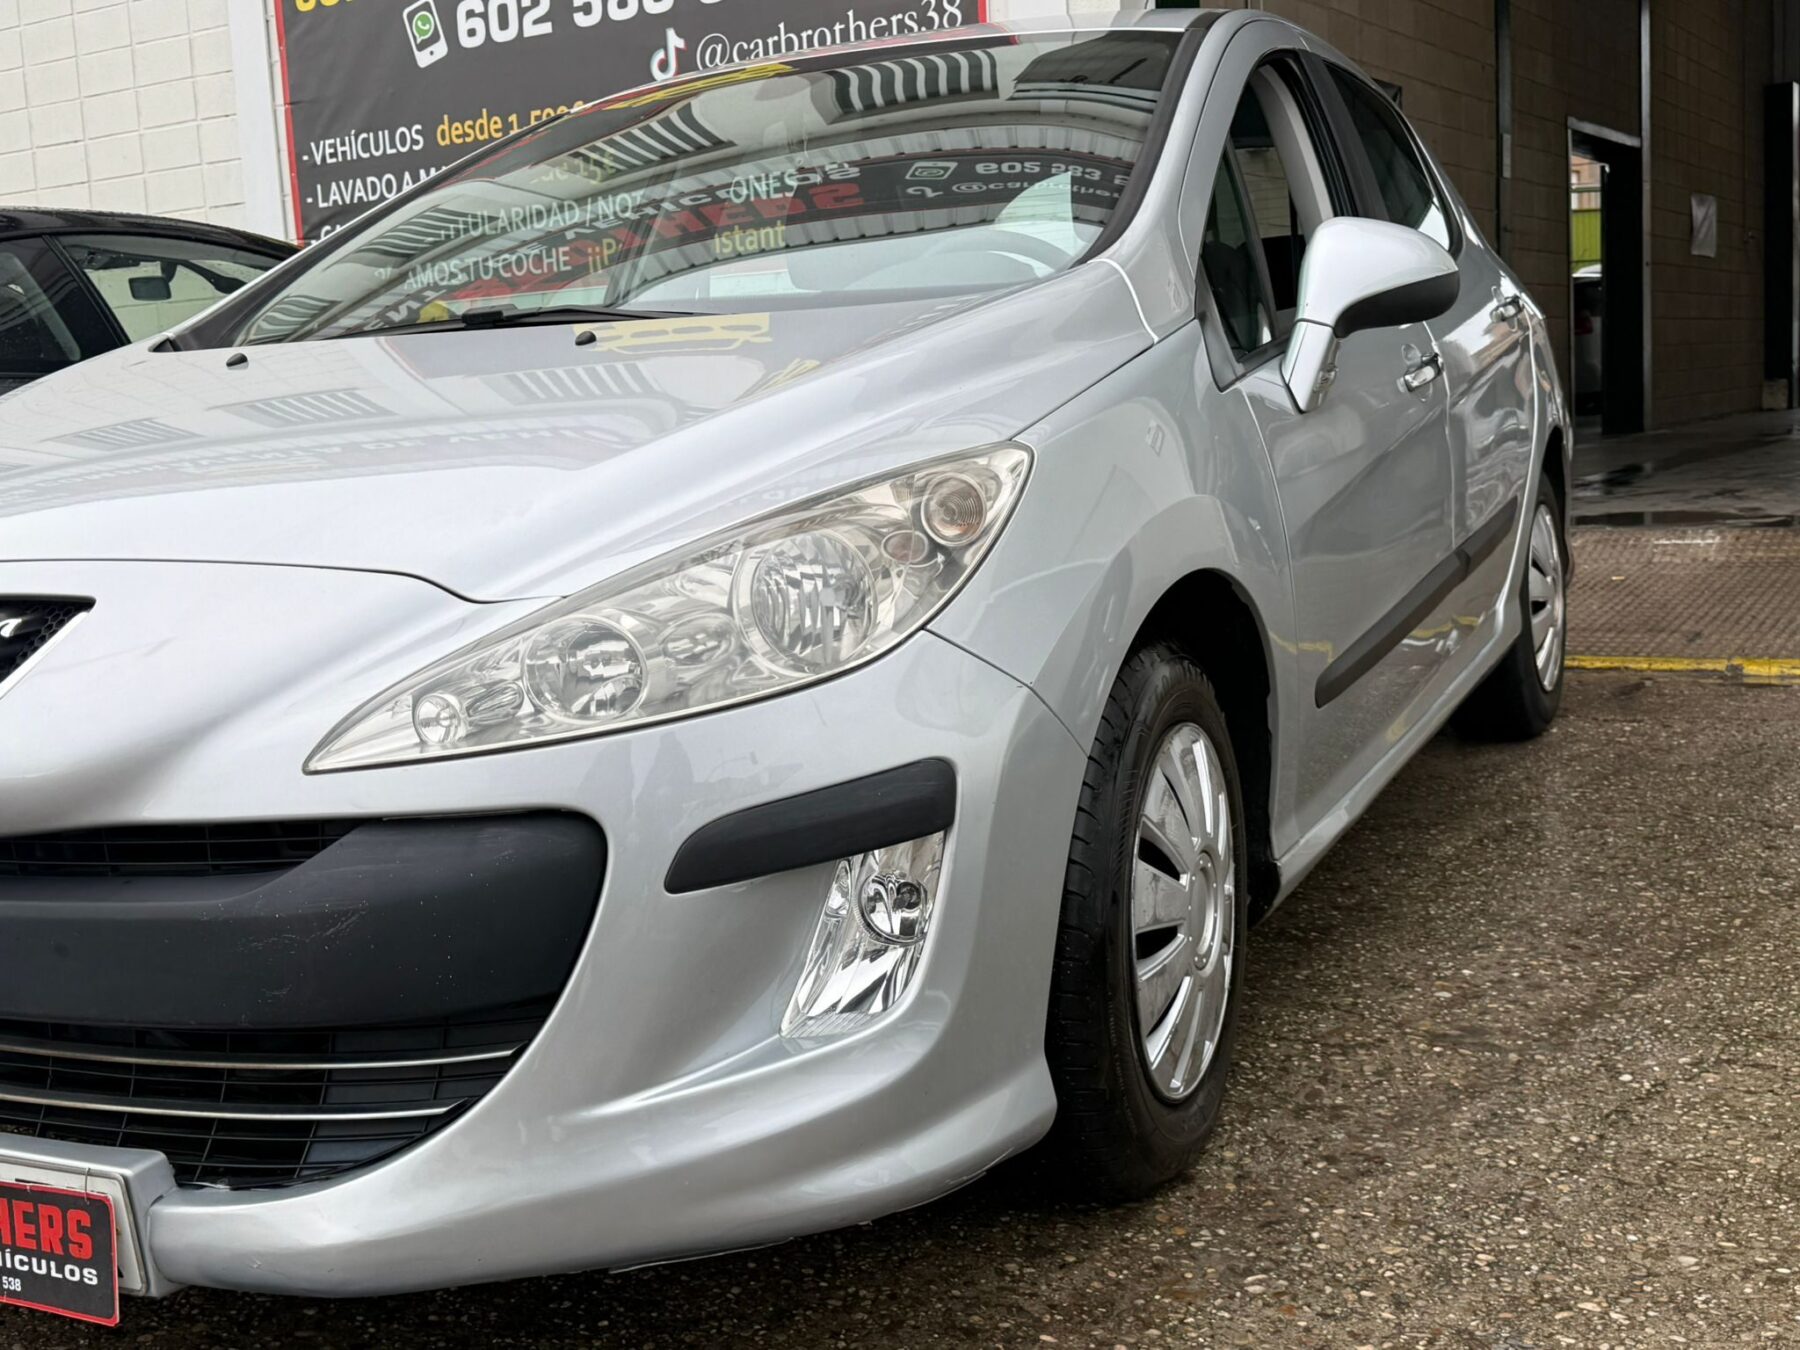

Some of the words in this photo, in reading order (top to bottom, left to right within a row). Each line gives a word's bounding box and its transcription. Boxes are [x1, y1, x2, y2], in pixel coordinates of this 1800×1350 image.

[456, 0, 553, 49] 602
[436, 108, 503, 146] desde
[0, 1249, 98, 1286] ÍCULOS
